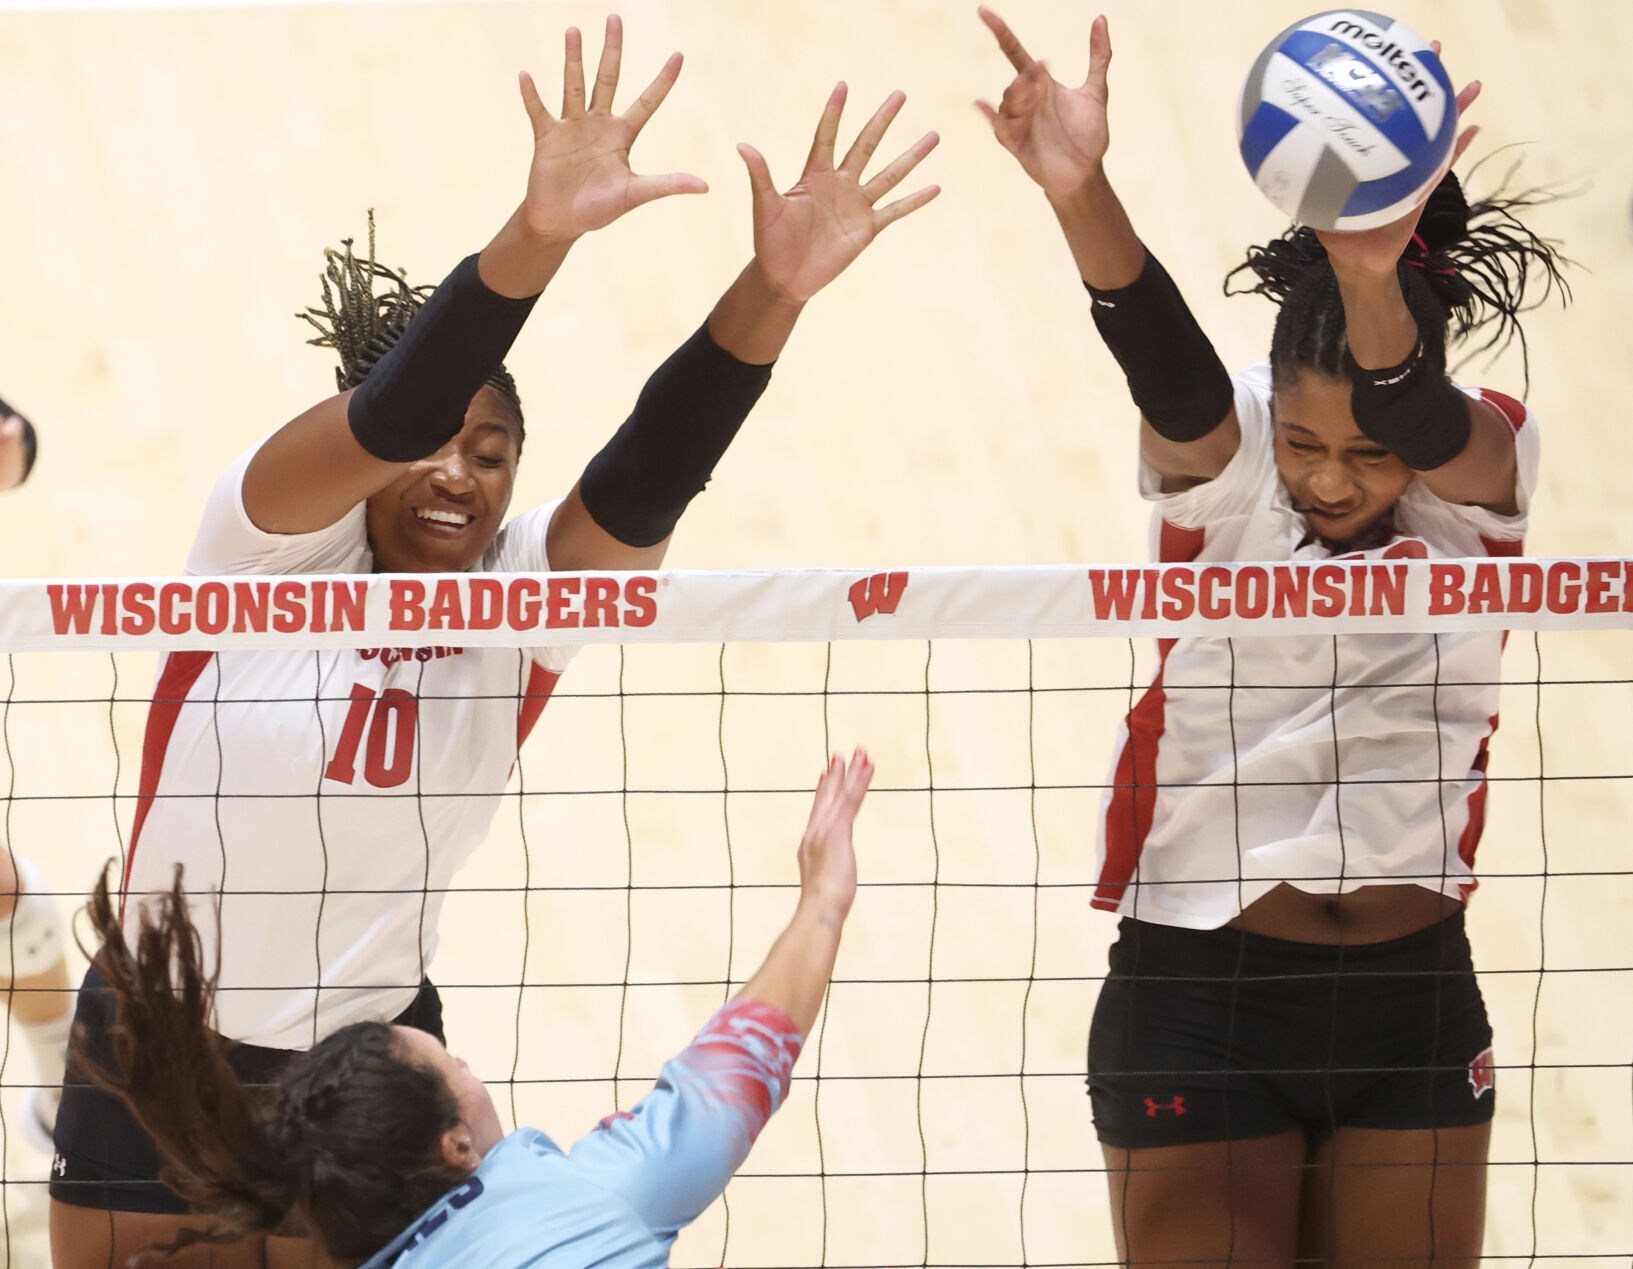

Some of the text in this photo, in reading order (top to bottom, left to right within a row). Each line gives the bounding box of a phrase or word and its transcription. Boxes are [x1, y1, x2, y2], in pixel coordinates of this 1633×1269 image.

[1330, 20, 1433, 101] molten
[47, 576, 658, 635] WISCONSIN BADGERS
[848, 572, 909, 623] W
[1088, 565, 1409, 621] WISCONSIN
[324, 682, 418, 788] 10
